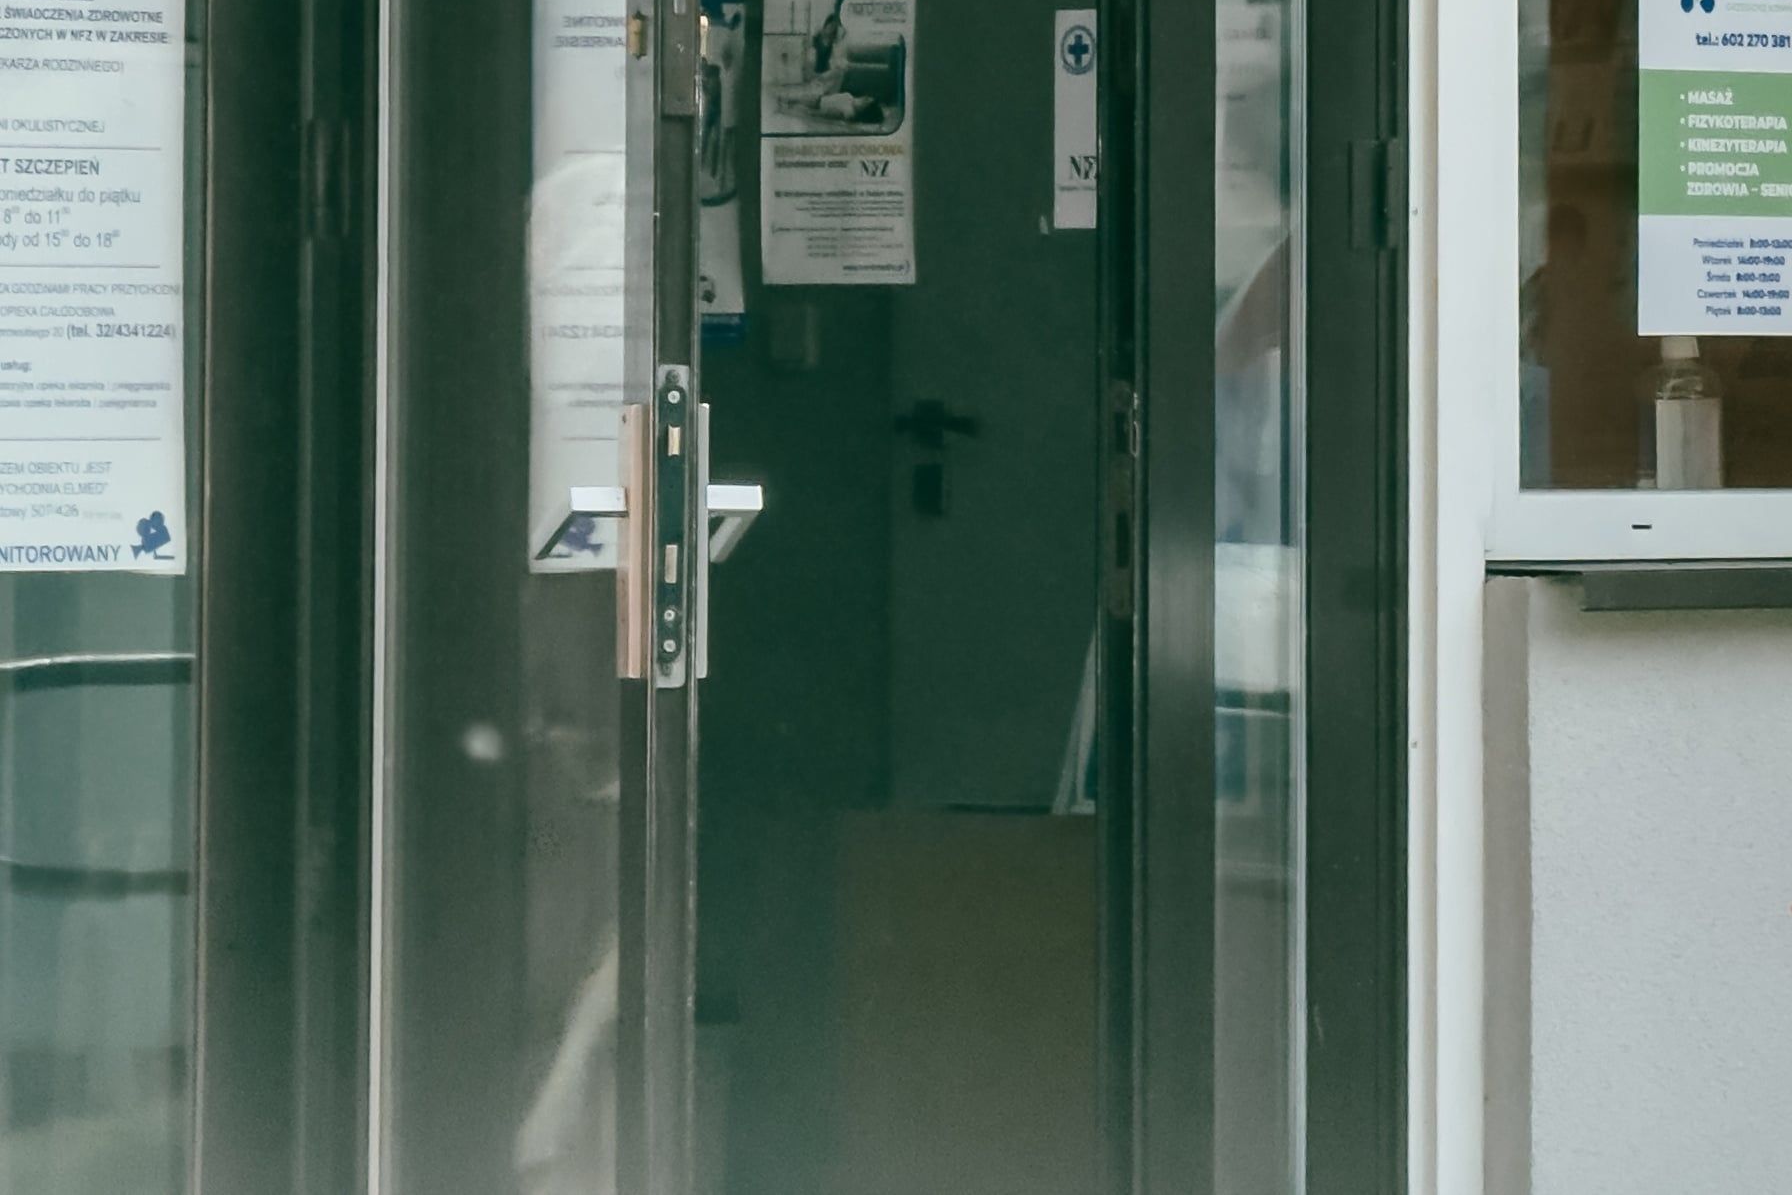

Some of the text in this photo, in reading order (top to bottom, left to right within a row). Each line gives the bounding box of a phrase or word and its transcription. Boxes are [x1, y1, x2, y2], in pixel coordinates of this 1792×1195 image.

[88, 9, 164, 24] ZDROWOTNE
[56, 28, 67, 42] W
[71, 28, 92, 42] NFZ
[95, 30, 107, 43] W
[1722, 33, 1745, 47] 602
[1746, 34, 1769, 48] 270
[1771, 34, 1792, 49] 381
[1687, 88, 1734, 106] MASAŻ
[1687, 114, 1788, 131] FIZYKOTERAPIA
[1687, 138, 1788, 154] KINEZYTERAPIA
[15, 155, 100, 175] SZCZEPIEŃ
[1687, 161, 1760, 177] PROMOCJA
[78, 187, 95, 203] do
[100, 188, 141, 206] piątku
[1686, 181, 1750, 197] ZDROWIA
[24, 209, 42, 225] do
[22, 232, 40, 248] od
[73, 233, 91, 249] do
